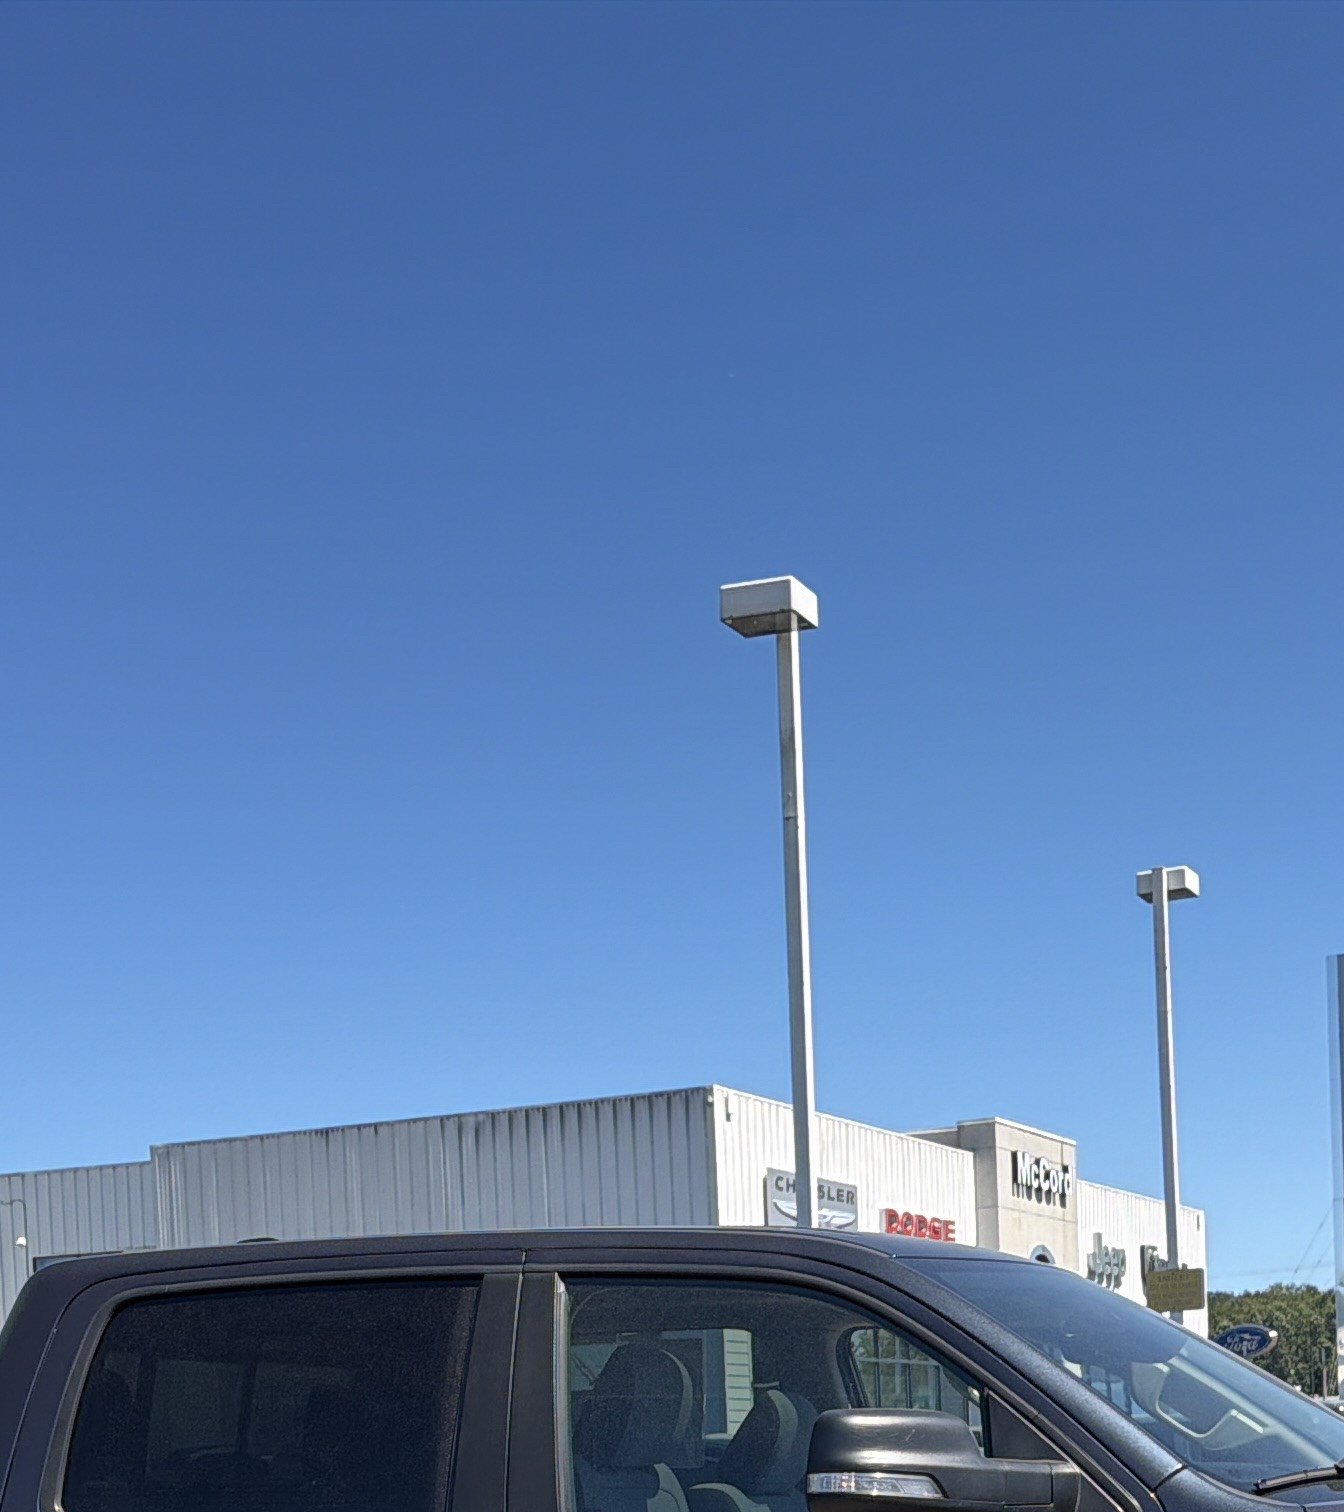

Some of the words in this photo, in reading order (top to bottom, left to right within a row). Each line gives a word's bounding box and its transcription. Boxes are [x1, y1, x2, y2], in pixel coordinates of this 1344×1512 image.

[774, 1175, 855, 1205] CHSLER
[1013, 1150, 1073, 1197] McCord
[884, 1208, 956, 1242] DODGE
